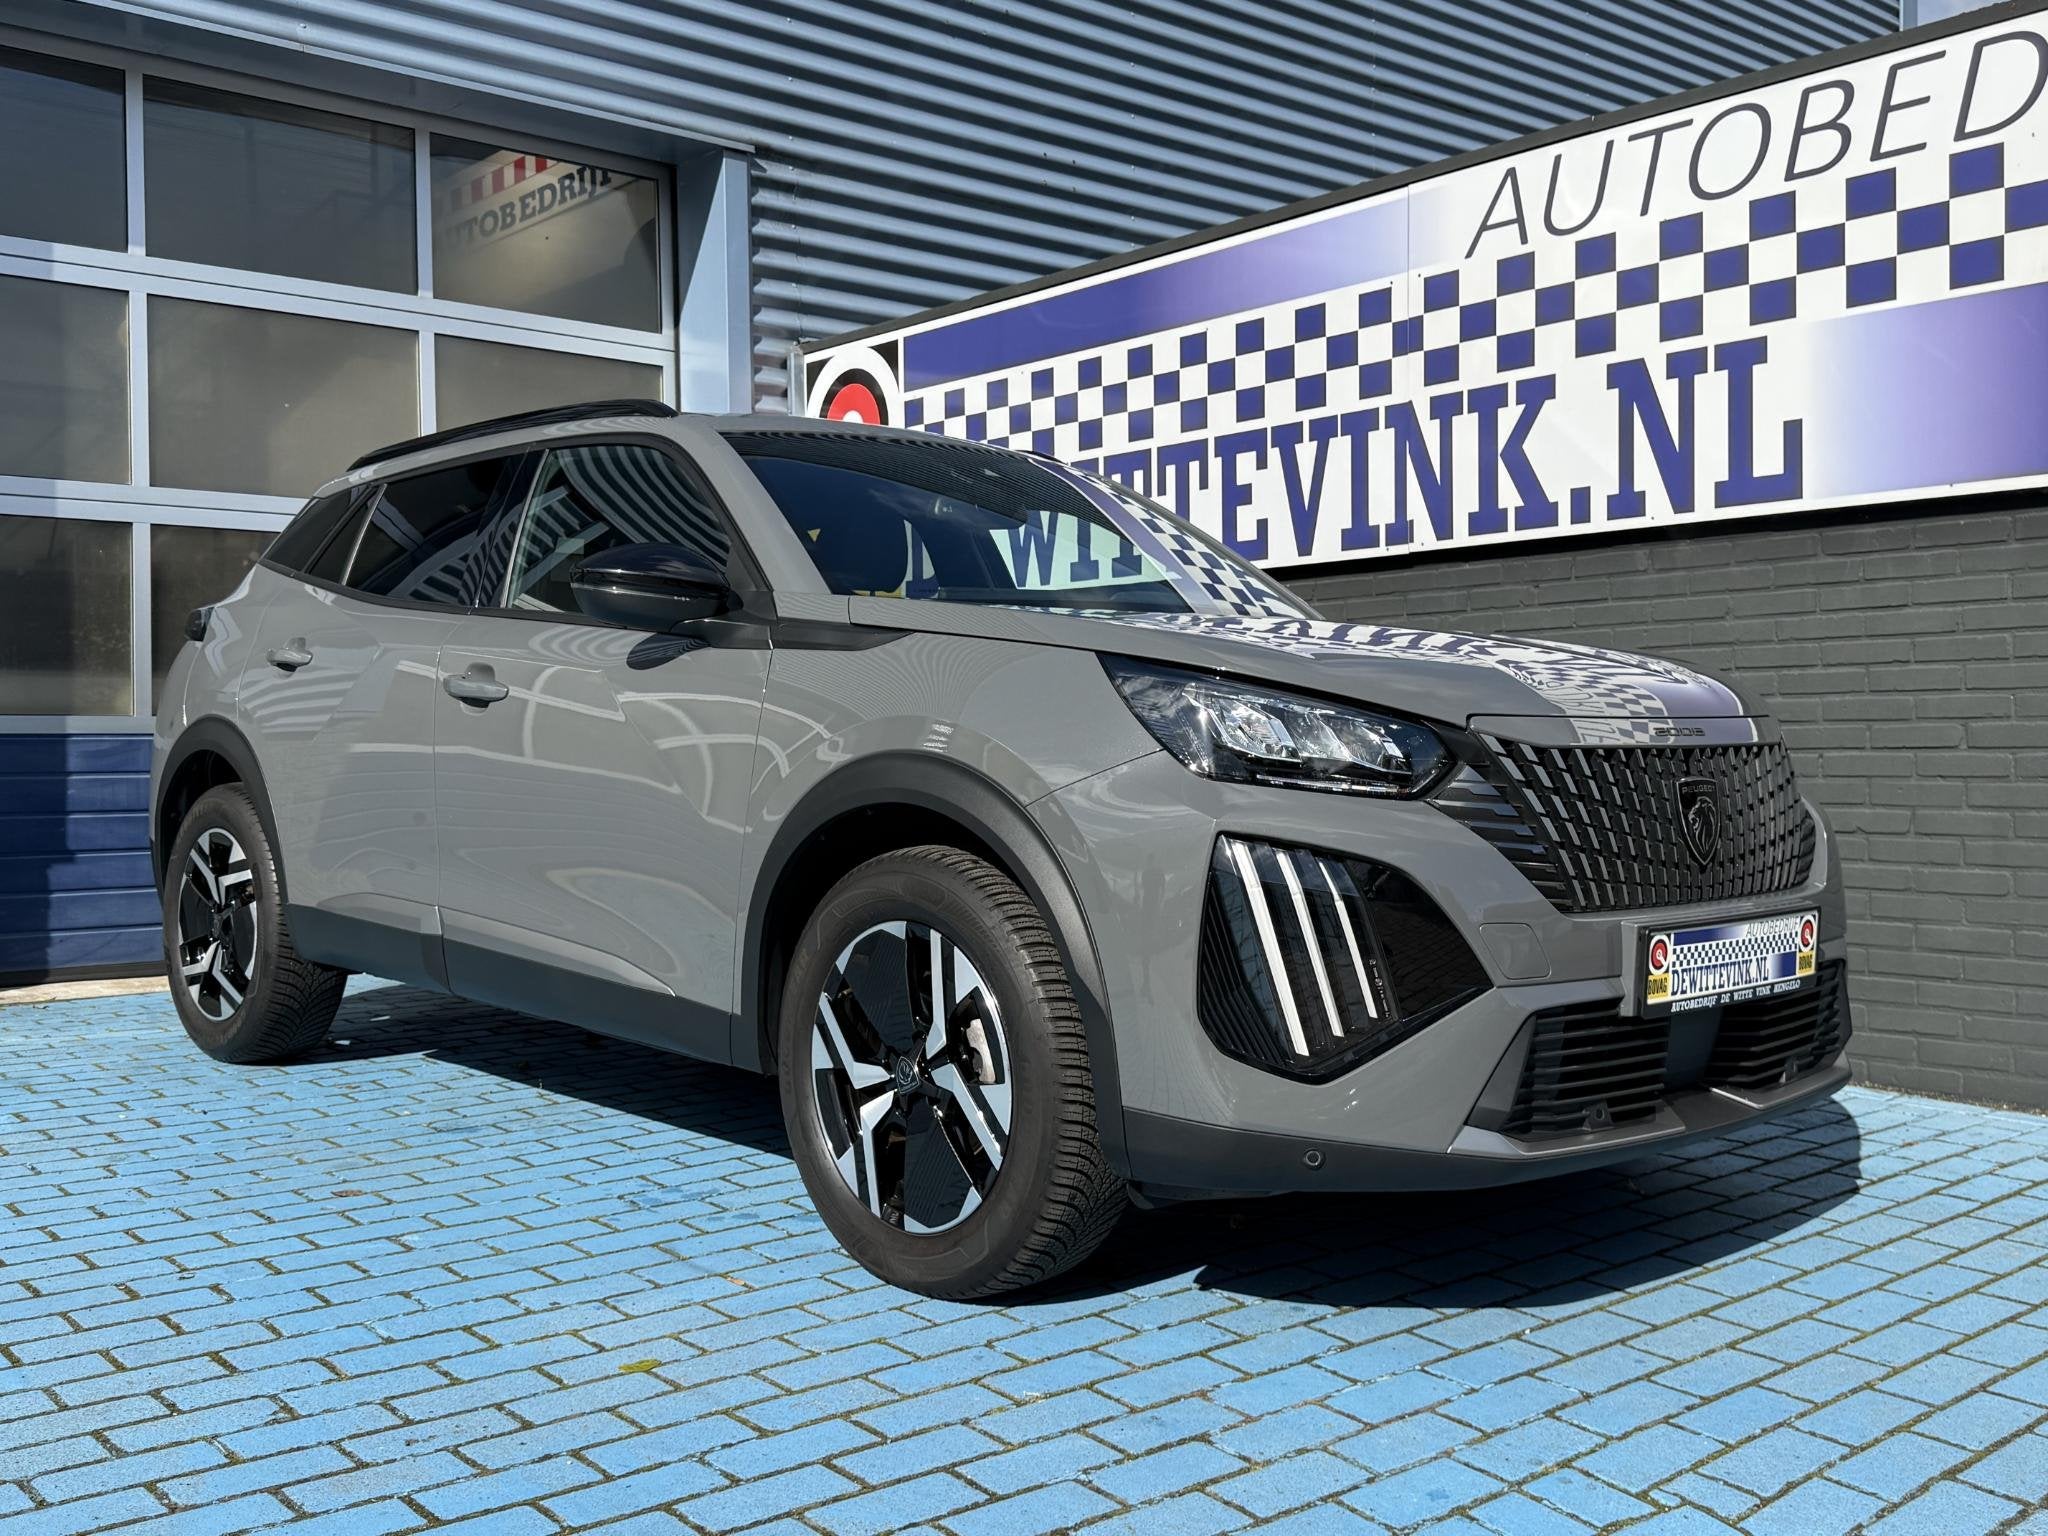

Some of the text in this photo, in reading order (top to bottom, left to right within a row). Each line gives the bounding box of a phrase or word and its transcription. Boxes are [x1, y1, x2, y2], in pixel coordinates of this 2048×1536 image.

[1681, 784, 1715, 794] PEUGEOT
[1746, 916, 1799, 937] AUTOBEDRIJF
[1648, 977, 1667, 995] BOVAG
[1671, 956, 1769, 996] DEWITTEVINK.NL
[1671, 980, 1801, 1012] AUTOBEDRIJF DE WITTE VINK HENGELO
